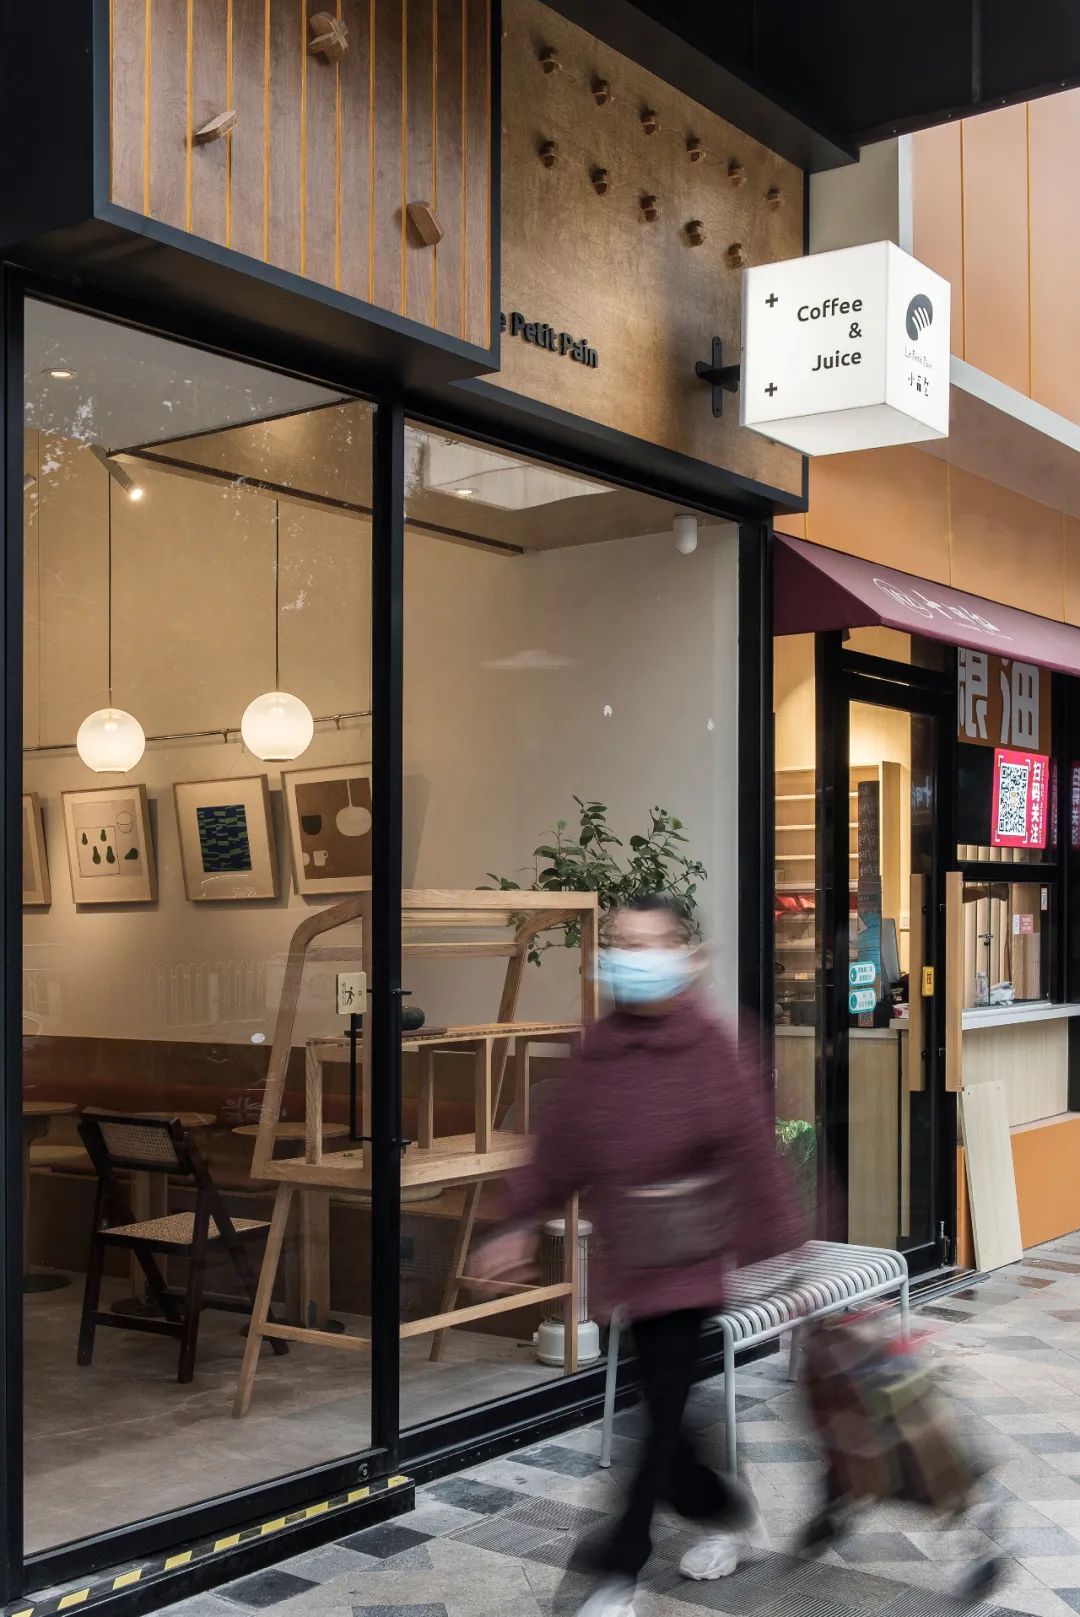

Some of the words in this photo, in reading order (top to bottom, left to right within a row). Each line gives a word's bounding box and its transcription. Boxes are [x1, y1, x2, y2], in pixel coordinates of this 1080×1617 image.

[797, 297, 863, 322] Coffee
[511, 312, 558, 352] Petit
[559, 332, 599, 368] Pain
[849, 322, 863, 339] &
[812, 350, 862, 371] Juice
